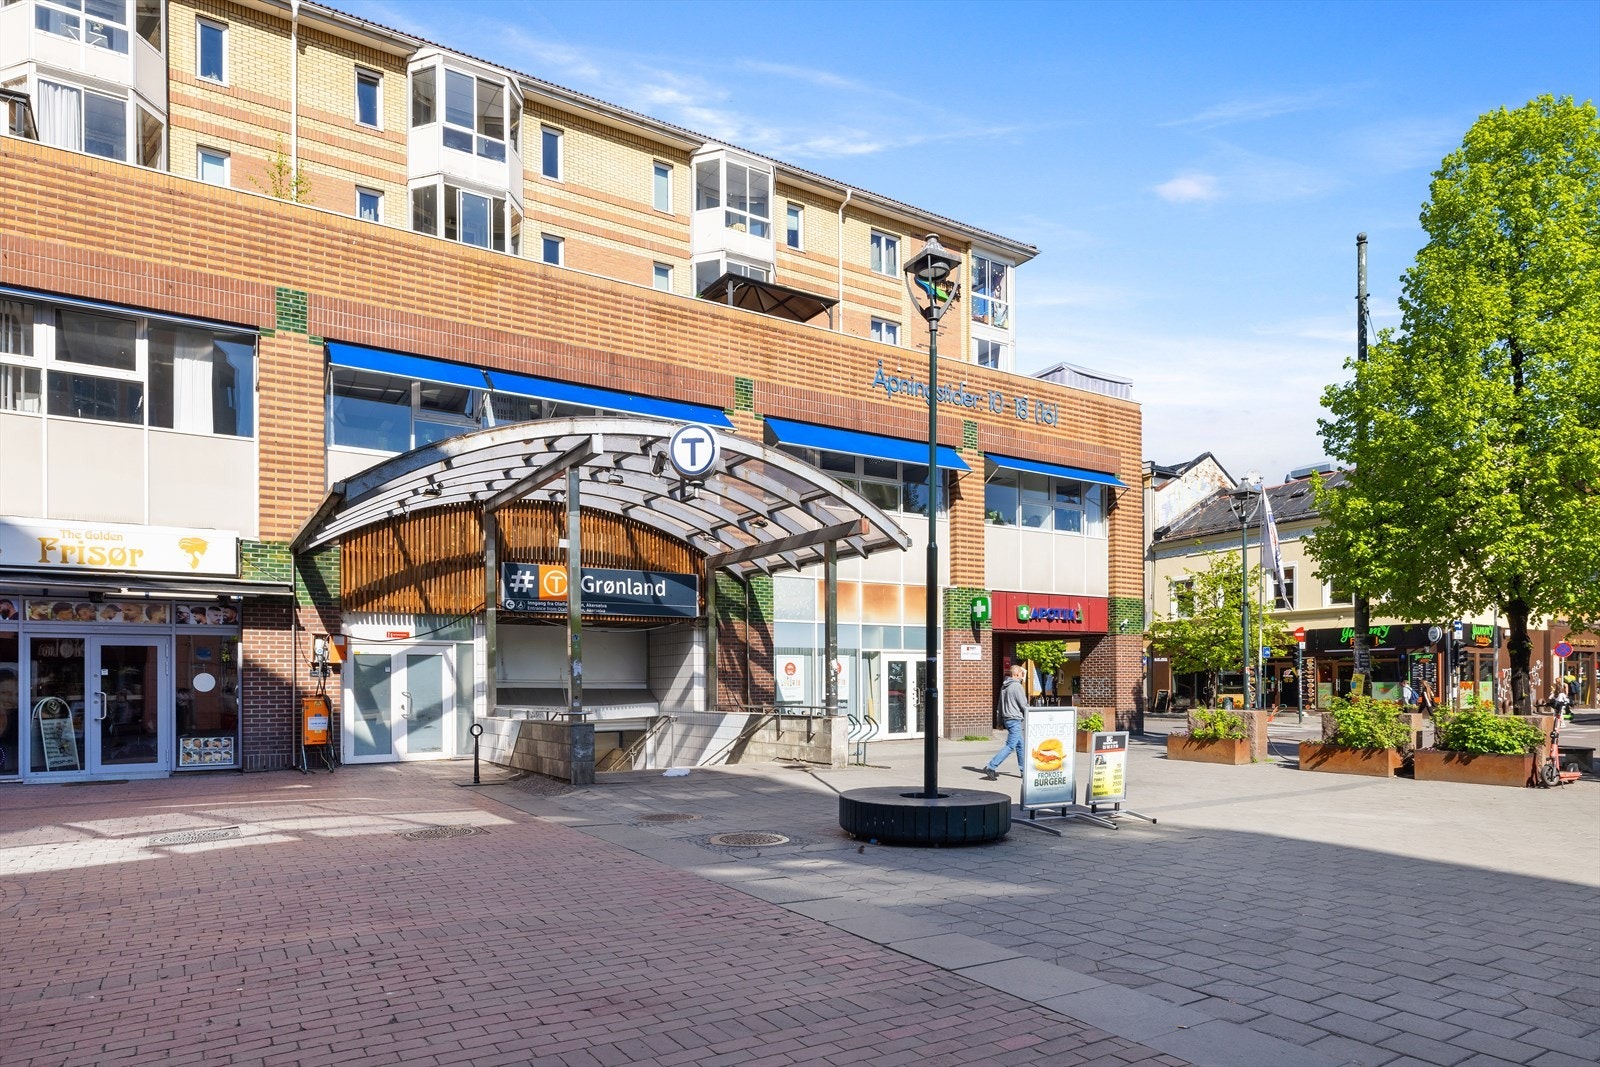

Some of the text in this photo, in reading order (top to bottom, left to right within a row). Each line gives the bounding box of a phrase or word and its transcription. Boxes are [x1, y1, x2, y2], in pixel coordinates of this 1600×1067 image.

[1035, 399, 1058, 428] (16)
[681, 437, 705, 466] T
[60, 529, 124, 541] The Golden
[38, 537, 144, 567] Frisør
[580, 575, 666, 597] Grønland
[1028, 723, 1073, 736] NYHET
[1034, 777, 1066, 787] BURGERE
